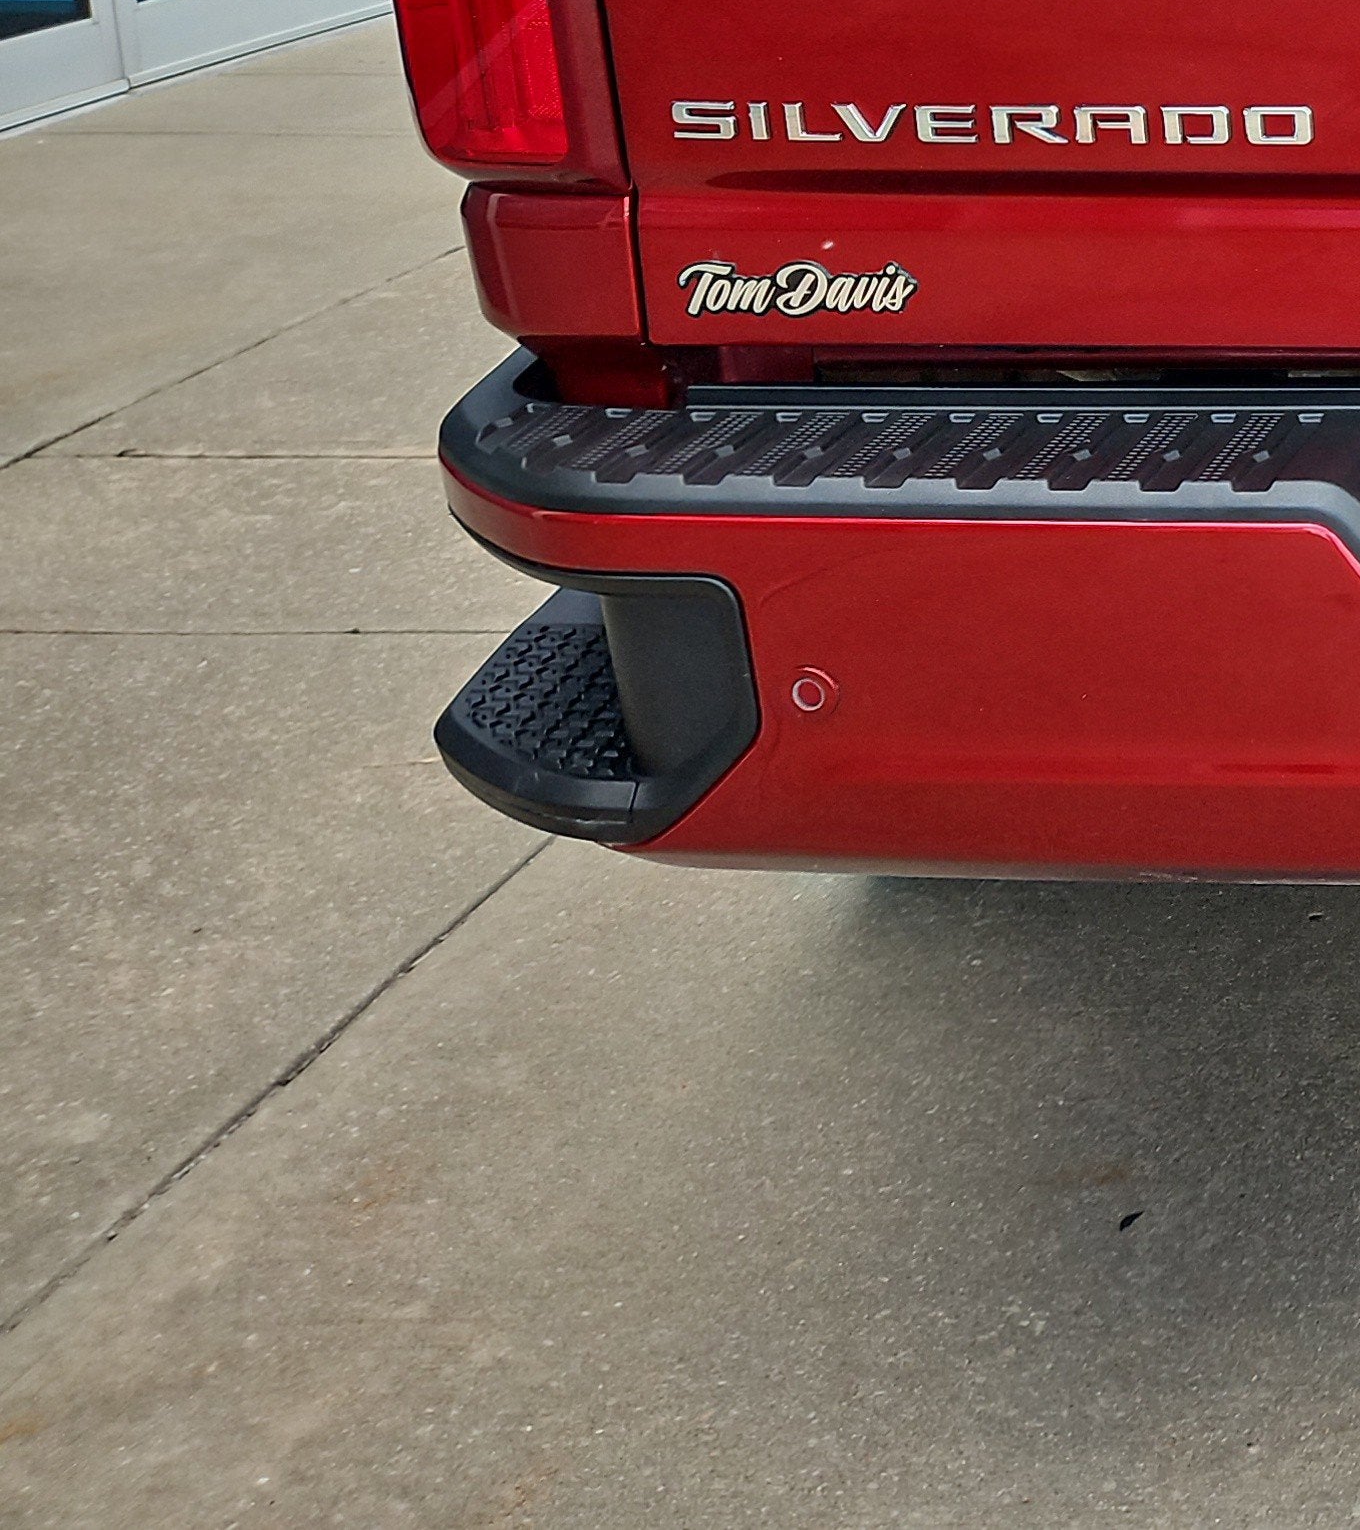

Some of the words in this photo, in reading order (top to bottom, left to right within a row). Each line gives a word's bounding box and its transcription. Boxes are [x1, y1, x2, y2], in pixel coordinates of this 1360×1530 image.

[669, 99, 1315, 147] SILVERADO
[679, 260, 777, 317] Tom
[775, 260, 918, 317] Davis
